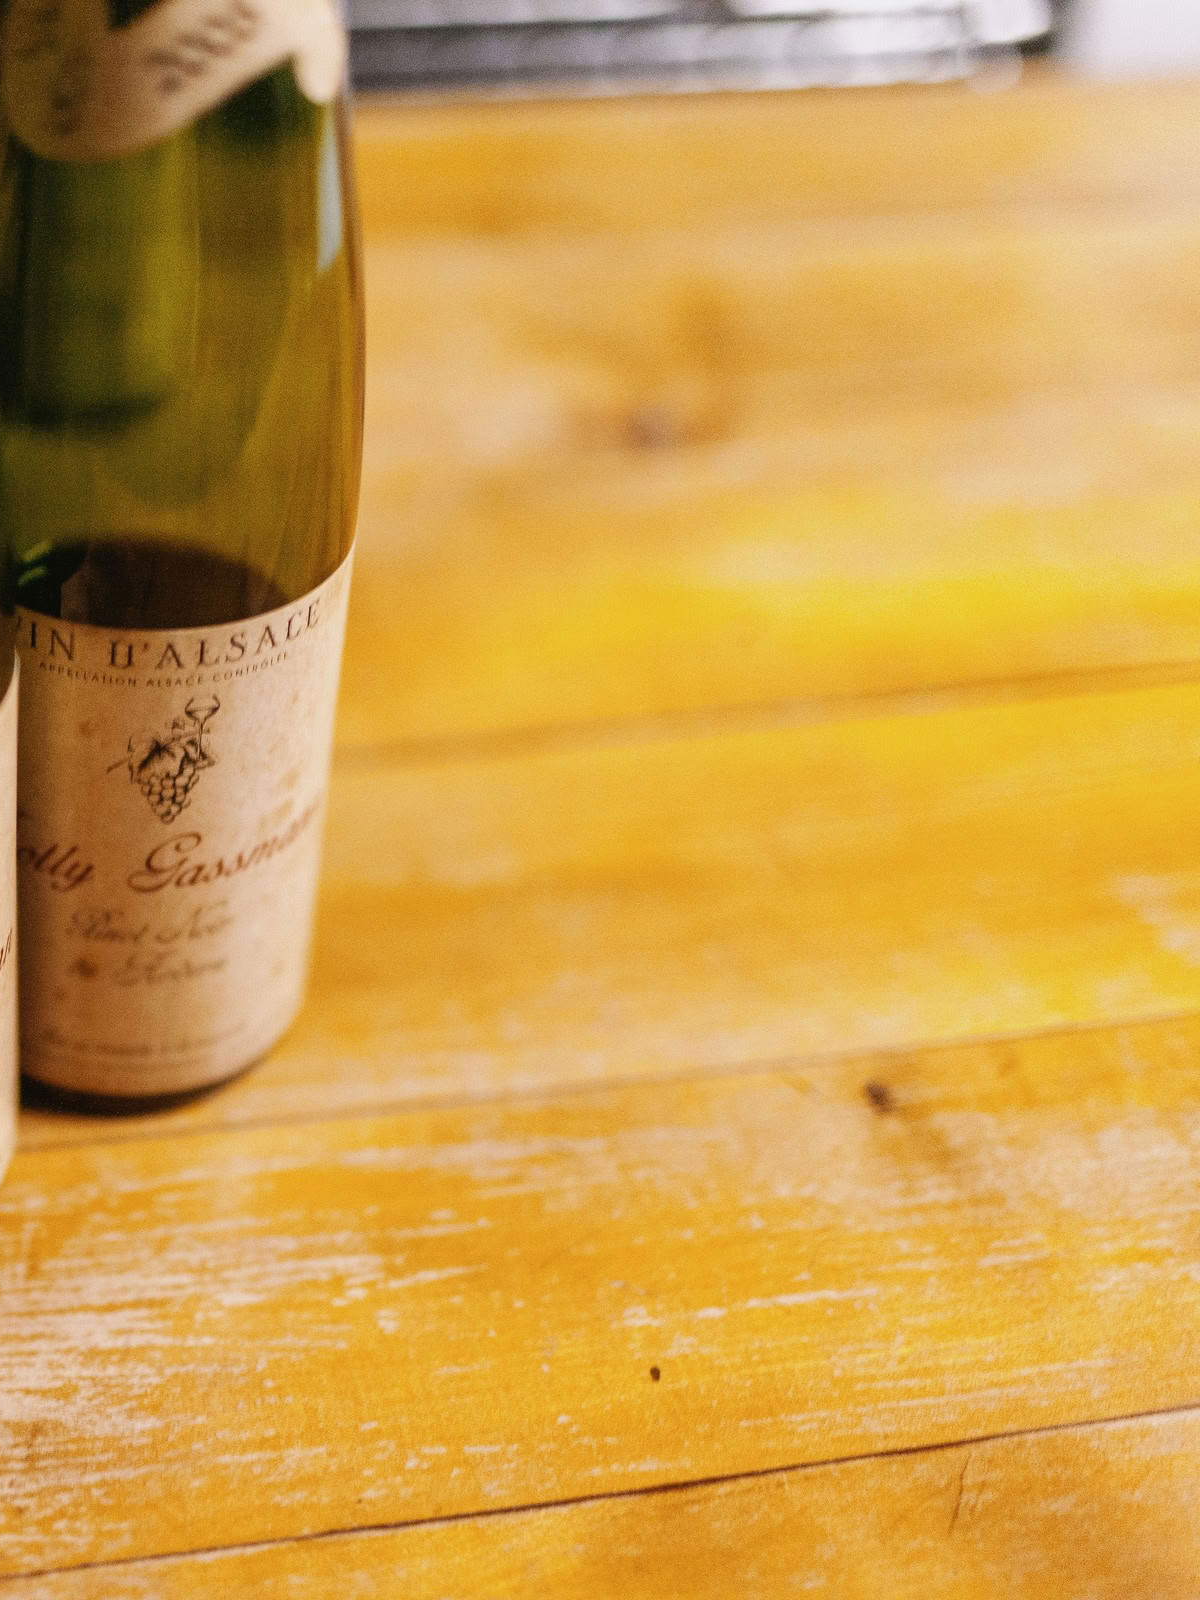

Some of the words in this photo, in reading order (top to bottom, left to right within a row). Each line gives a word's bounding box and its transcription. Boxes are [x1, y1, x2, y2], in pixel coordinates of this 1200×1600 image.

[108, 598, 322, 671] D'ALSACE
[38, 660, 138, 688] APPELLATION
[146, 675, 203, 688] ALSACE
